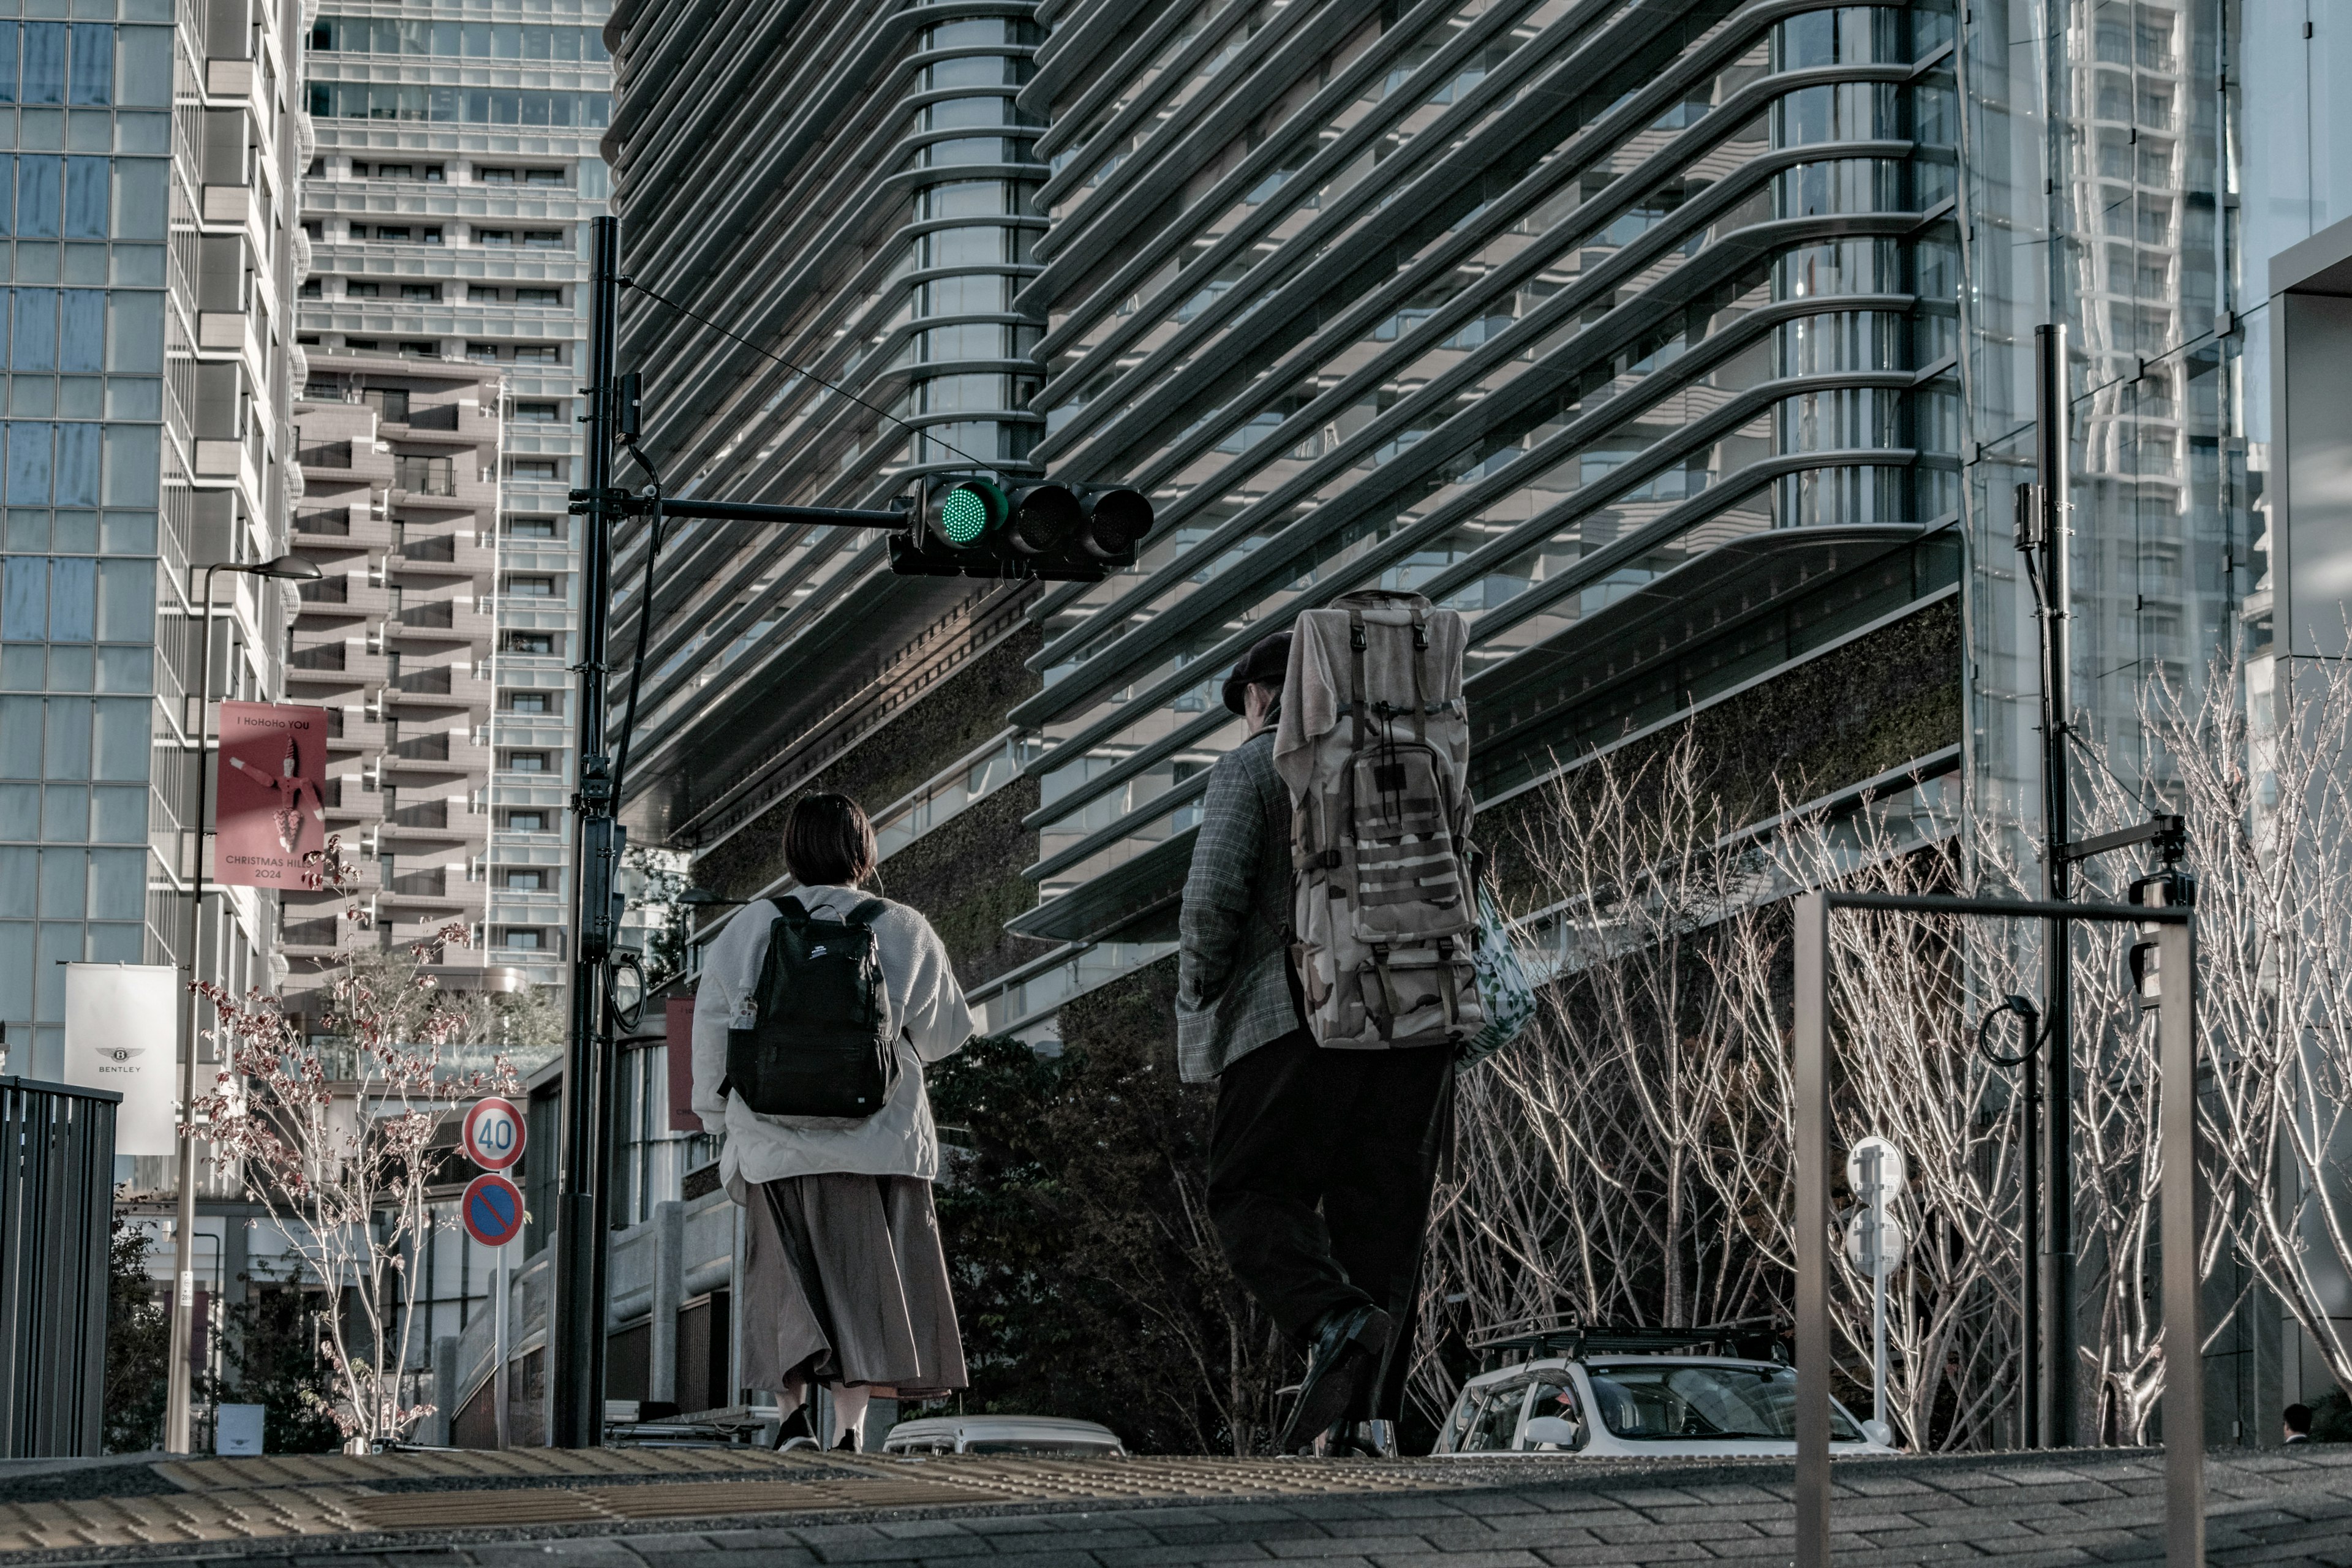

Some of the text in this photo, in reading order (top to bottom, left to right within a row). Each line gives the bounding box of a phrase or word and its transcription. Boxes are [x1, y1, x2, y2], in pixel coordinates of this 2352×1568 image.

[244, 717, 285, 728] HoHoHo
[288, 720, 309, 730] YOU
[225, 855, 284, 867] CHRISTMAS
[255, 869, 281, 878] 2024
[478, 1118, 511, 1150] 40
